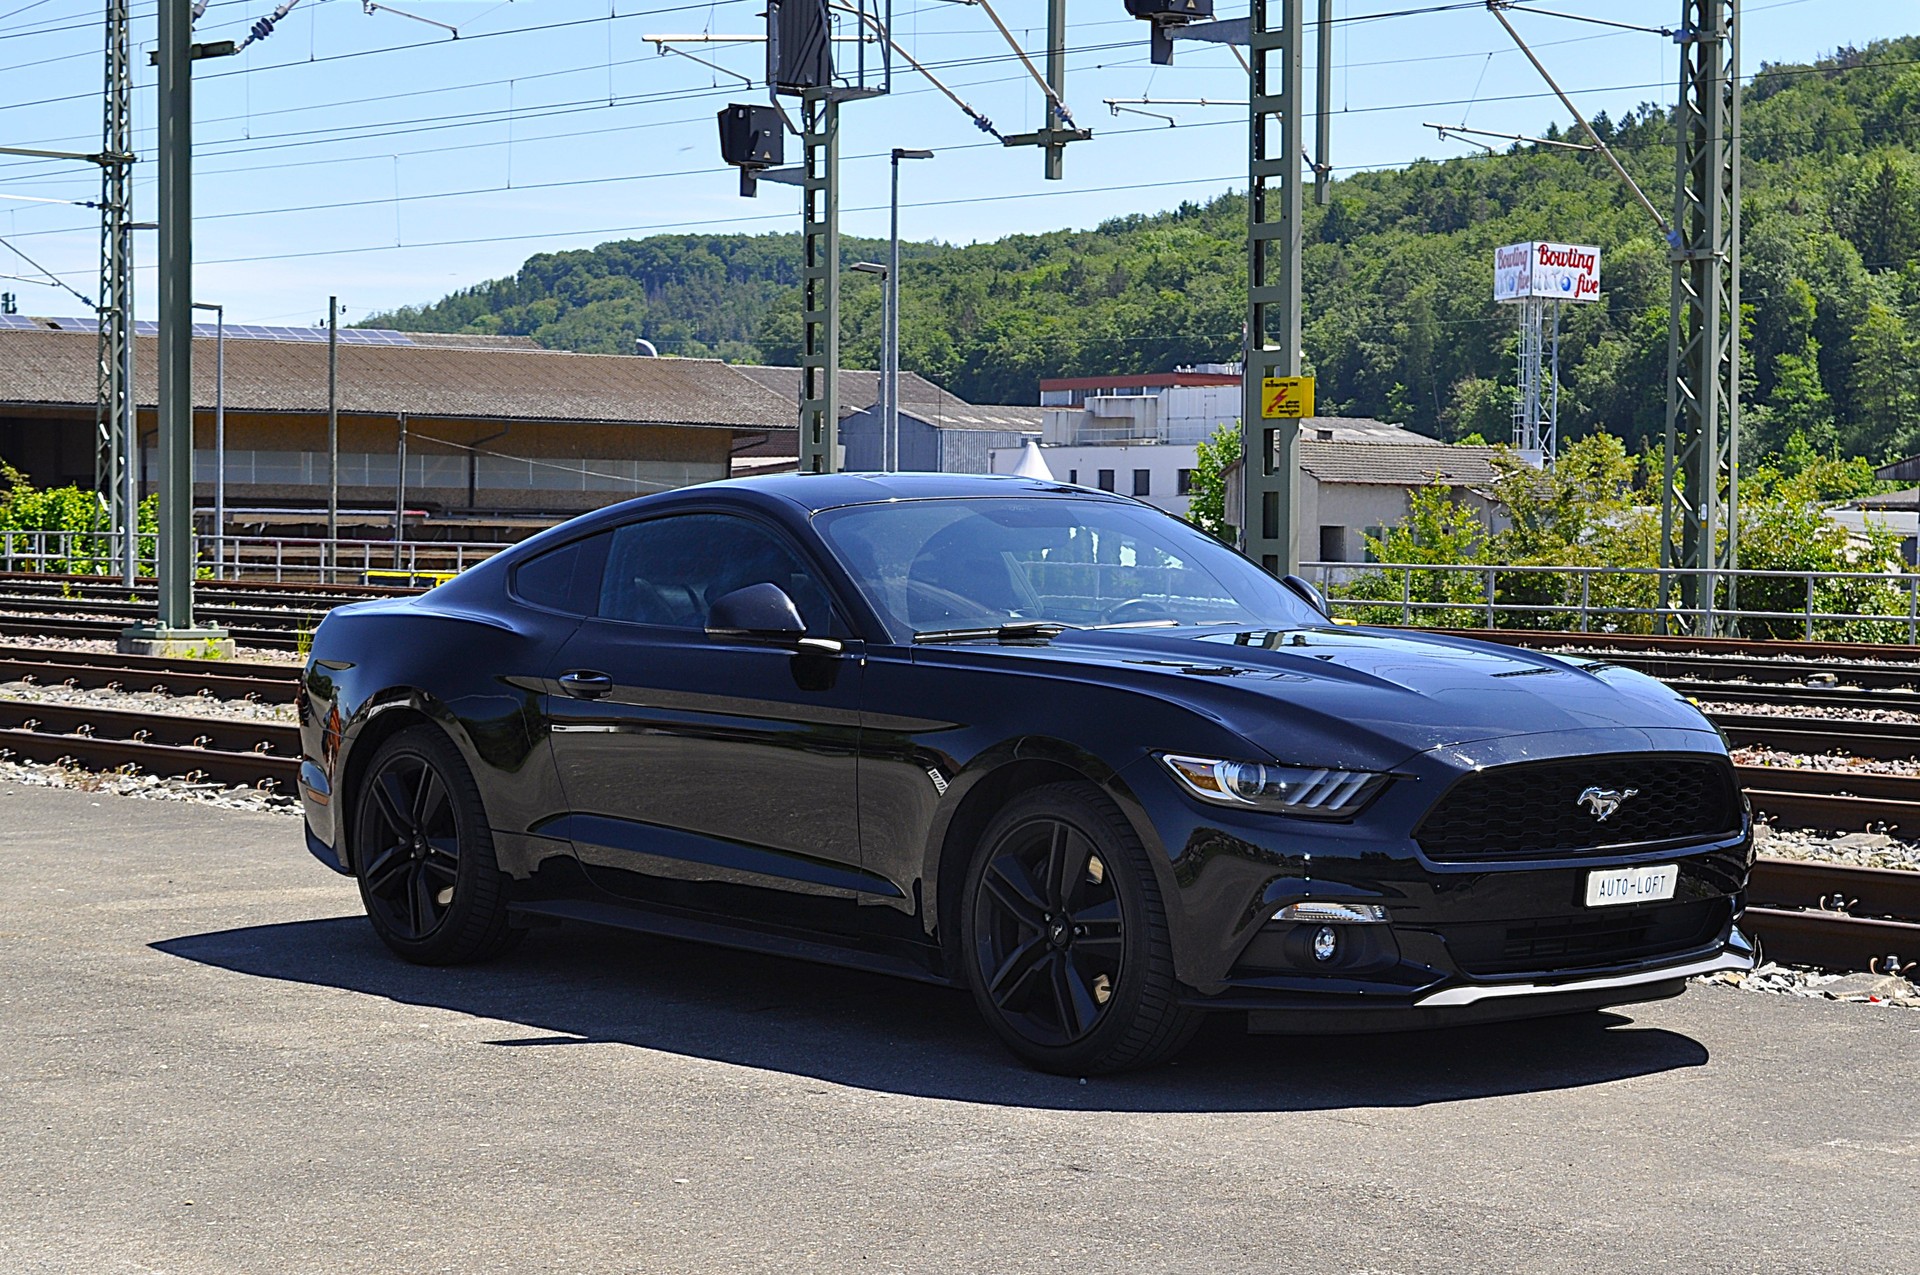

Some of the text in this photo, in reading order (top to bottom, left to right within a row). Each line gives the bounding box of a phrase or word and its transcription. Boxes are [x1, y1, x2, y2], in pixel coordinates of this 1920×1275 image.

[1497, 247, 1527, 271] Bowling
[1539, 244, 1595, 275] Bowling
[1516, 271, 1529, 296] five
[1575, 273, 1598, 297] five
[1599, 875, 1666, 897] AUTO-LOFT
